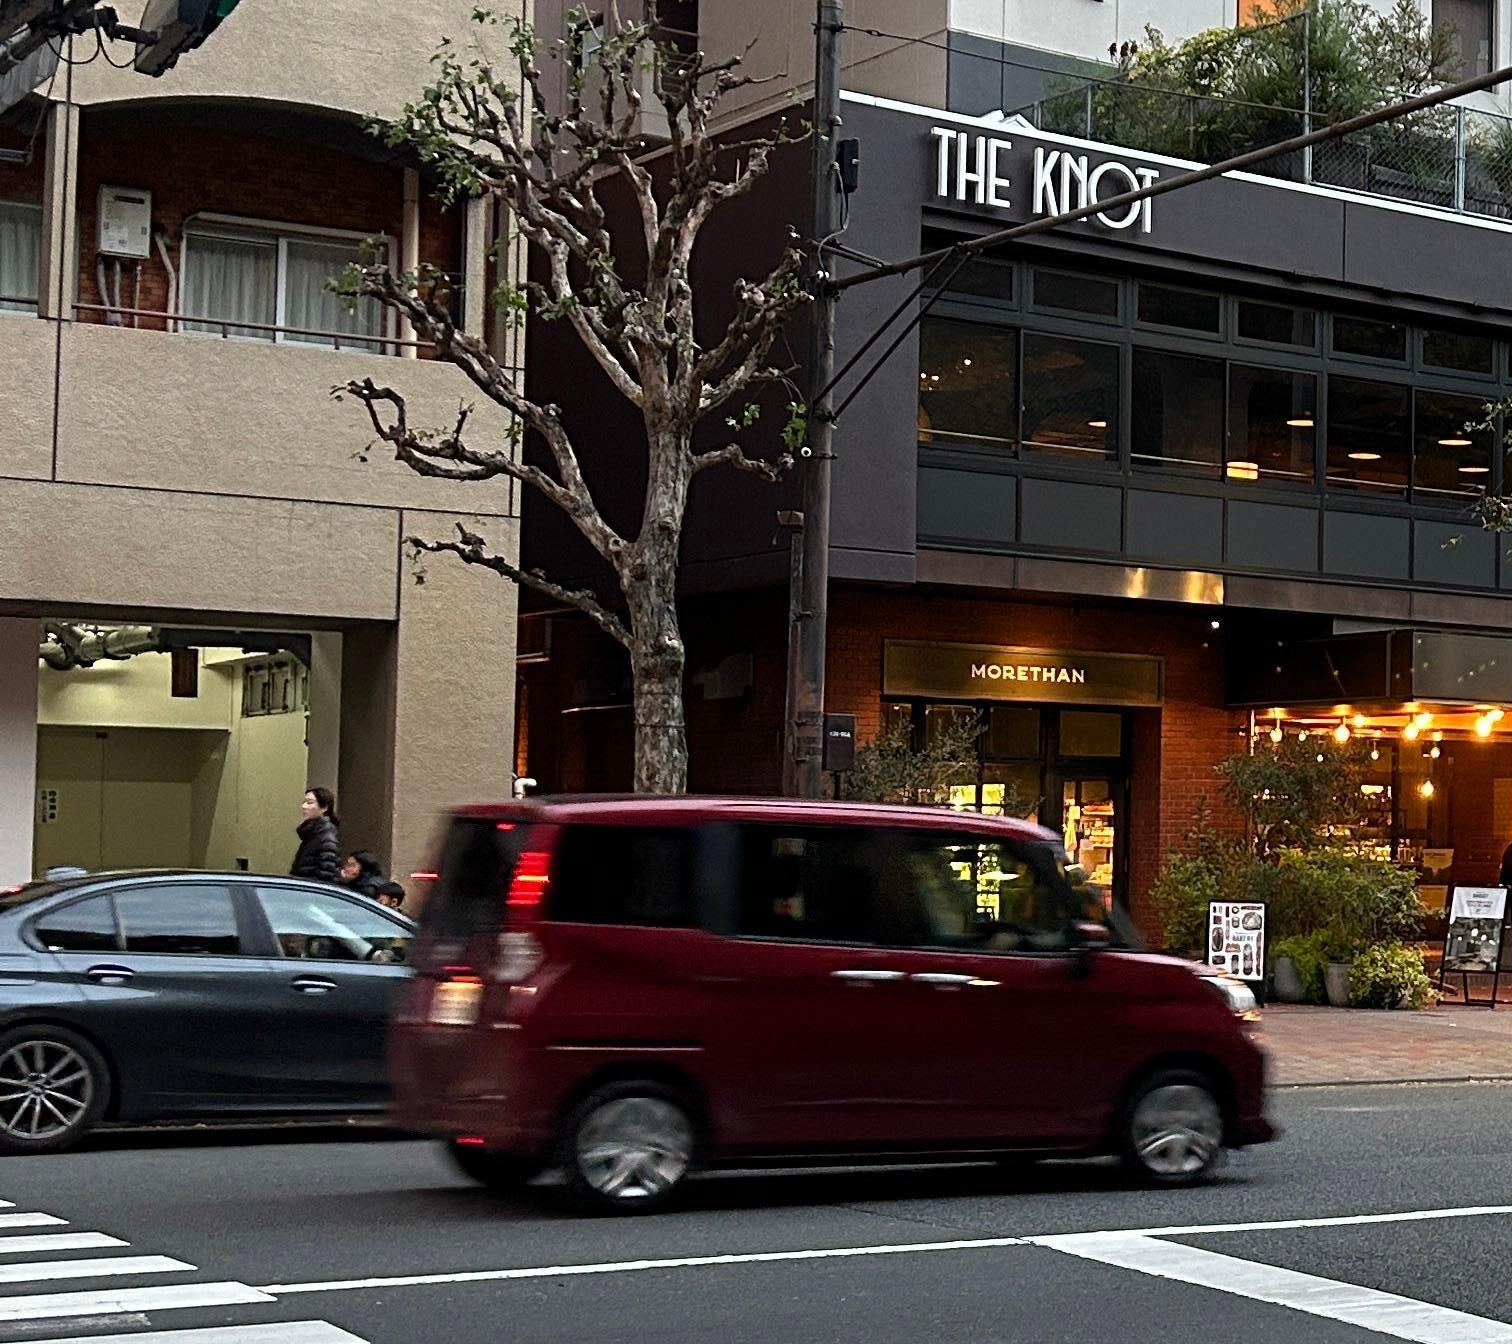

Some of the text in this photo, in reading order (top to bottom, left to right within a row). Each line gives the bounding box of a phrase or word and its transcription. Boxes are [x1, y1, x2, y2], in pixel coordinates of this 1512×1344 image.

[931, 126, 1160, 234] THE KNOT
[971, 663, 1085, 683] MORETHAN
